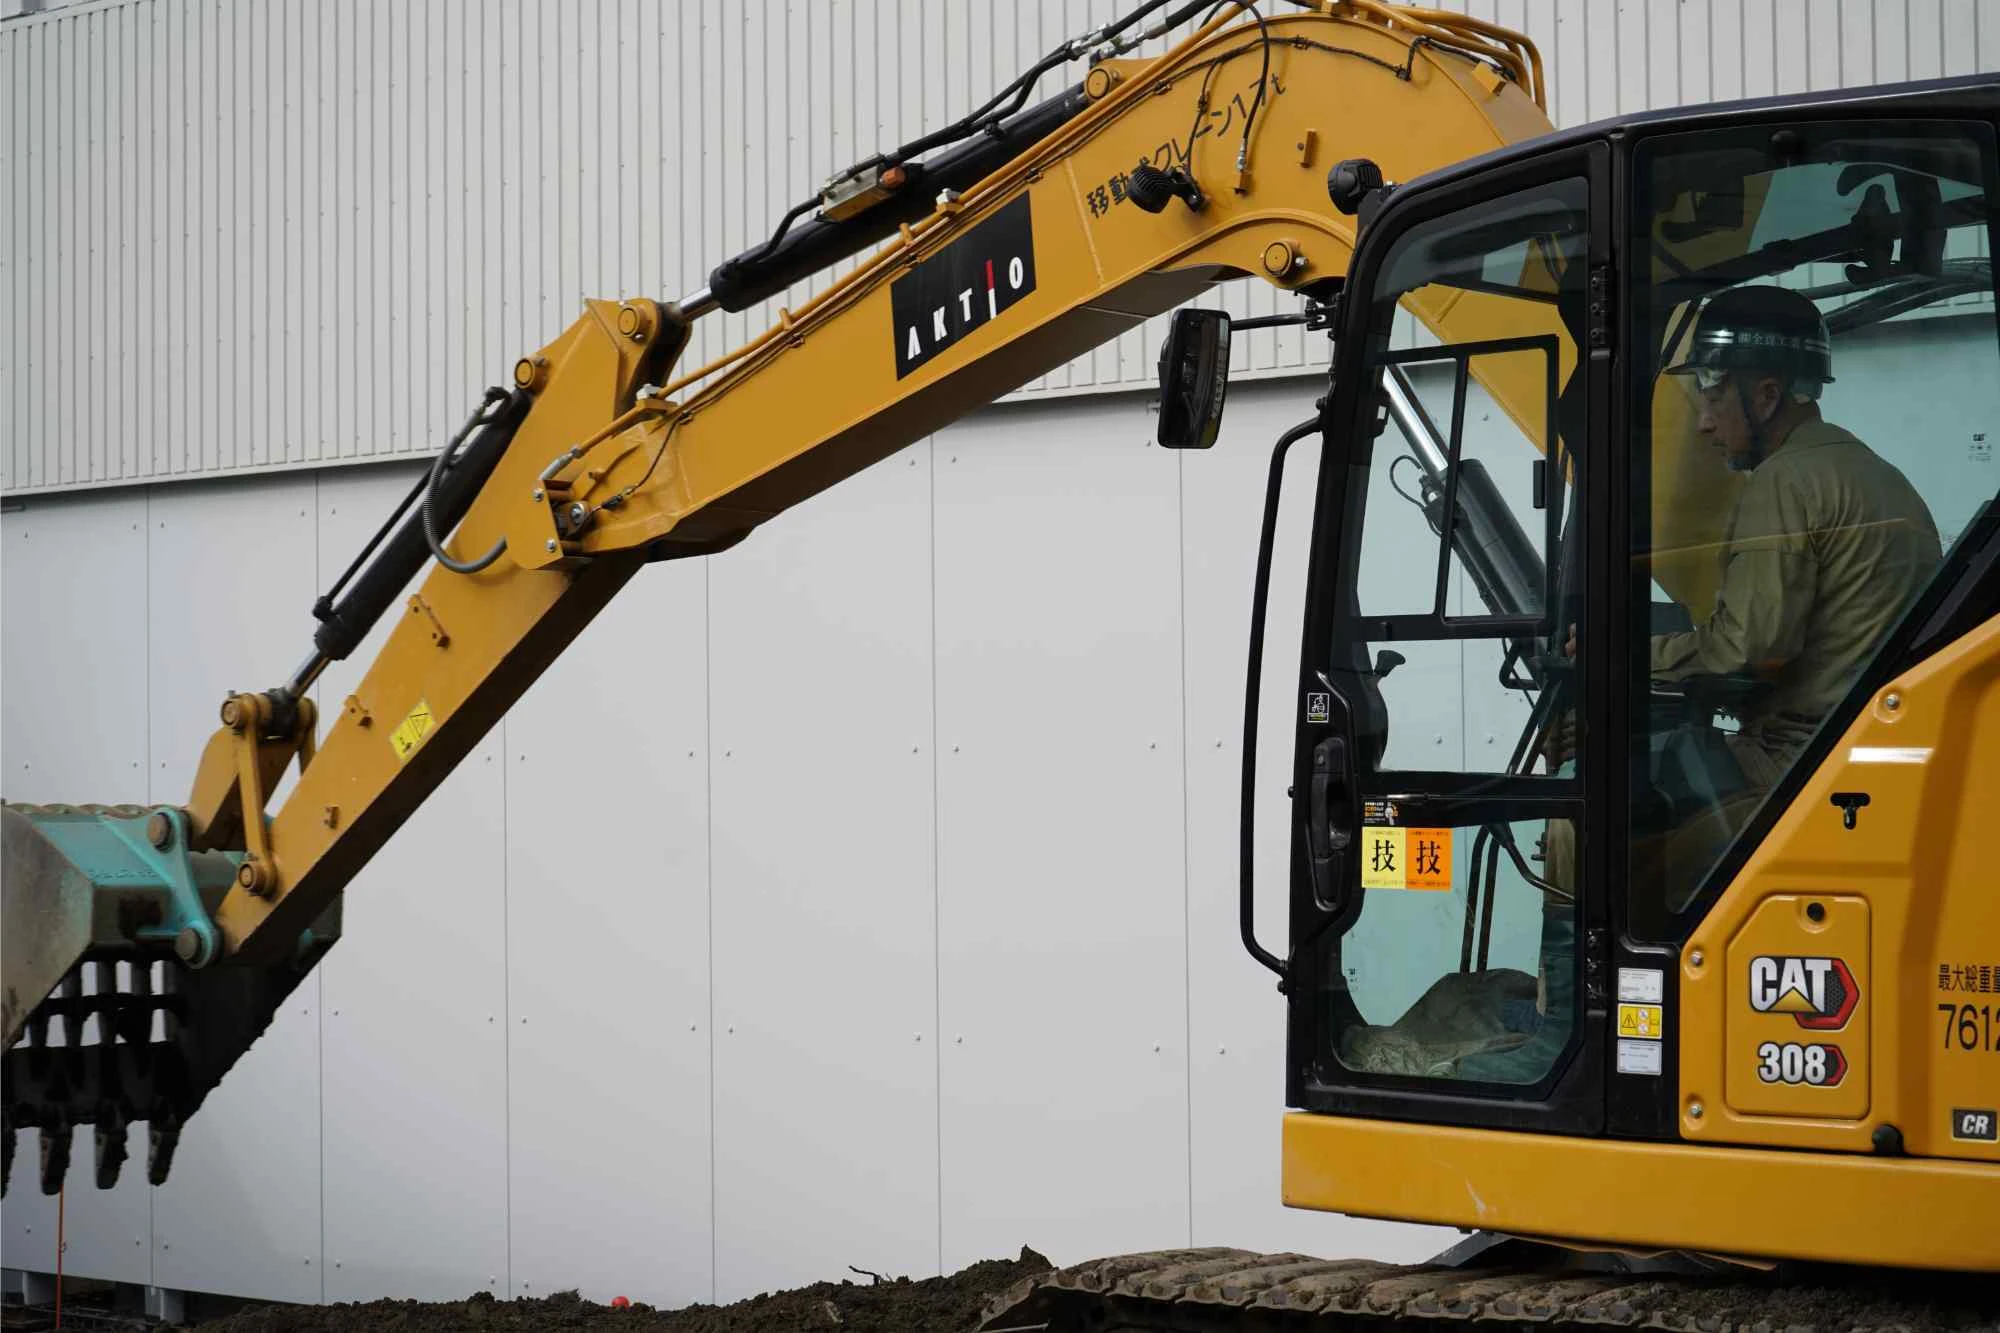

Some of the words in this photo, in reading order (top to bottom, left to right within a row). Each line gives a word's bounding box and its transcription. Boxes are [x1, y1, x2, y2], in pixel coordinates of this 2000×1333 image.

[907, 256, 1024, 361] AKTIO
[1372, 839, 1397, 872] 技
[1416, 840, 1442, 875] 技
[1751, 957, 1832, 1012] CAT
[1938, 1003, 2000, 1052] 761
[1759, 1043, 1827, 1084] 308
[1961, 1115, 1989, 1134] CR
